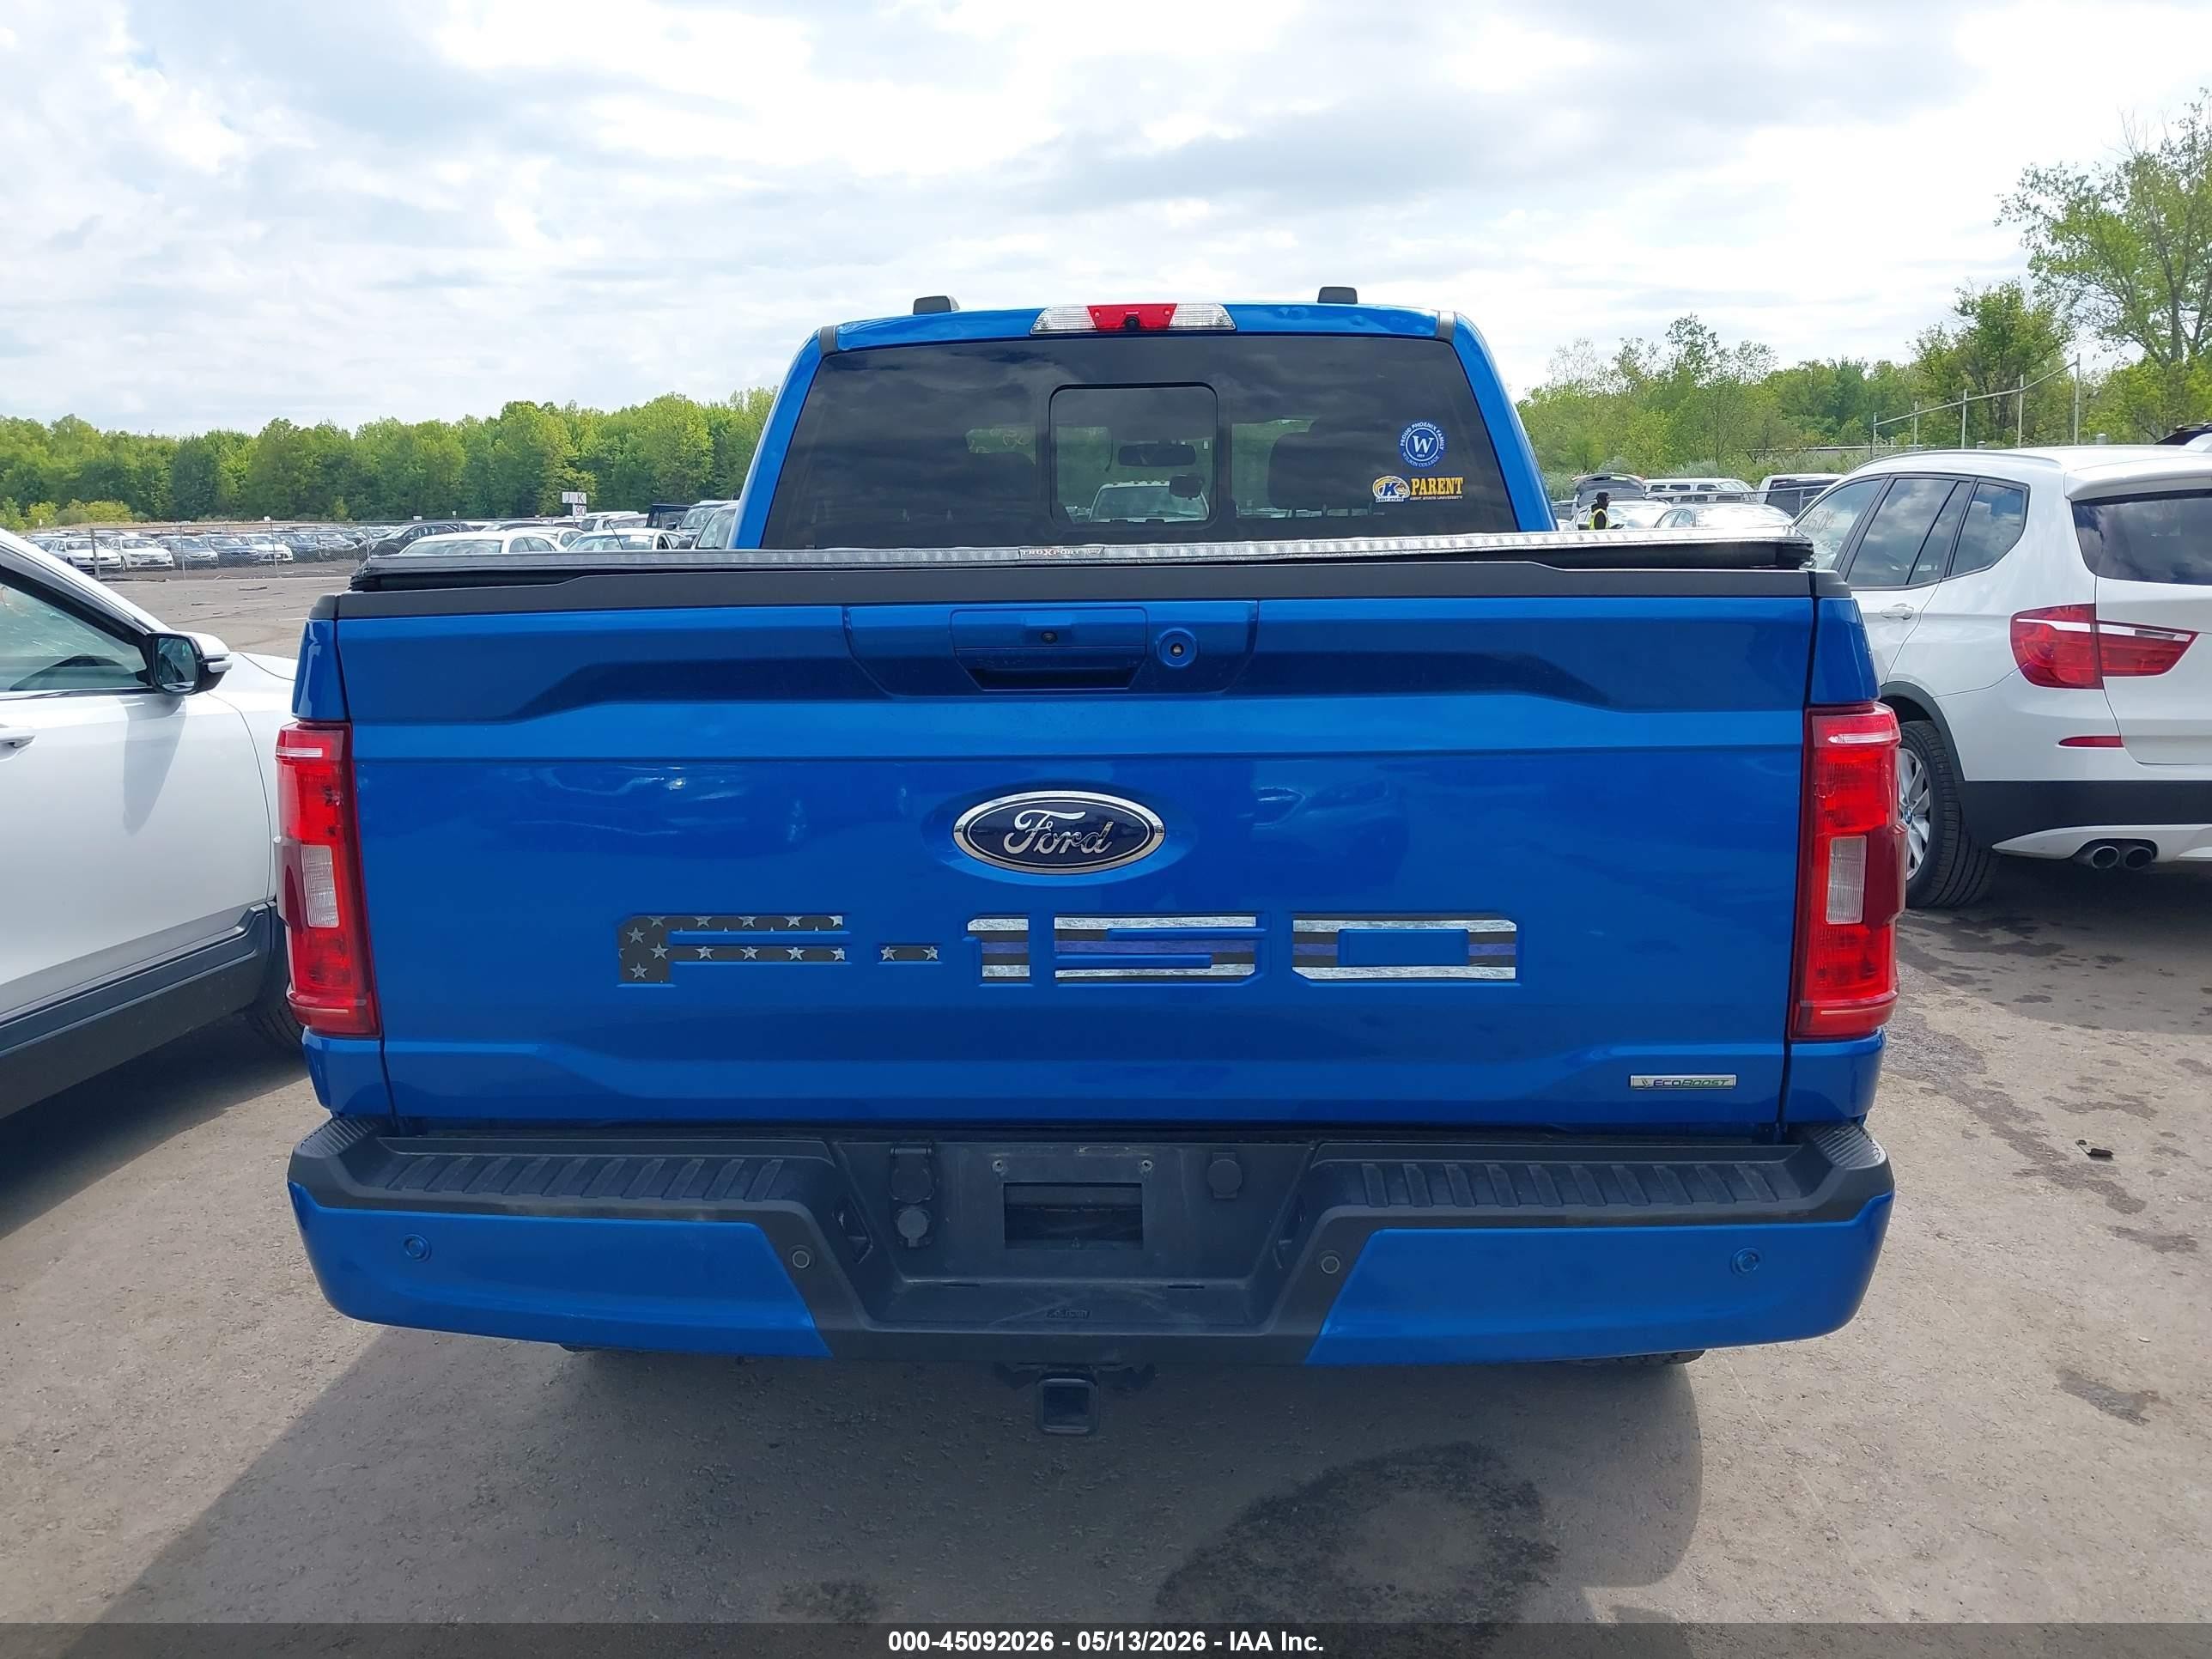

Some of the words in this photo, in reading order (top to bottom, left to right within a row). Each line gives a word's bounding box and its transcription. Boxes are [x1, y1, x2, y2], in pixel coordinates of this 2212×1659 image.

[1413, 435, 1434, 453] W
[1411, 477, 1463, 495] PARENT
[577, 493, 584, 503] K
[576, 506, 586, 516] 90
[1003, 809, 1115, 854] Ford
[618, 913, 1518, 983] F-150
